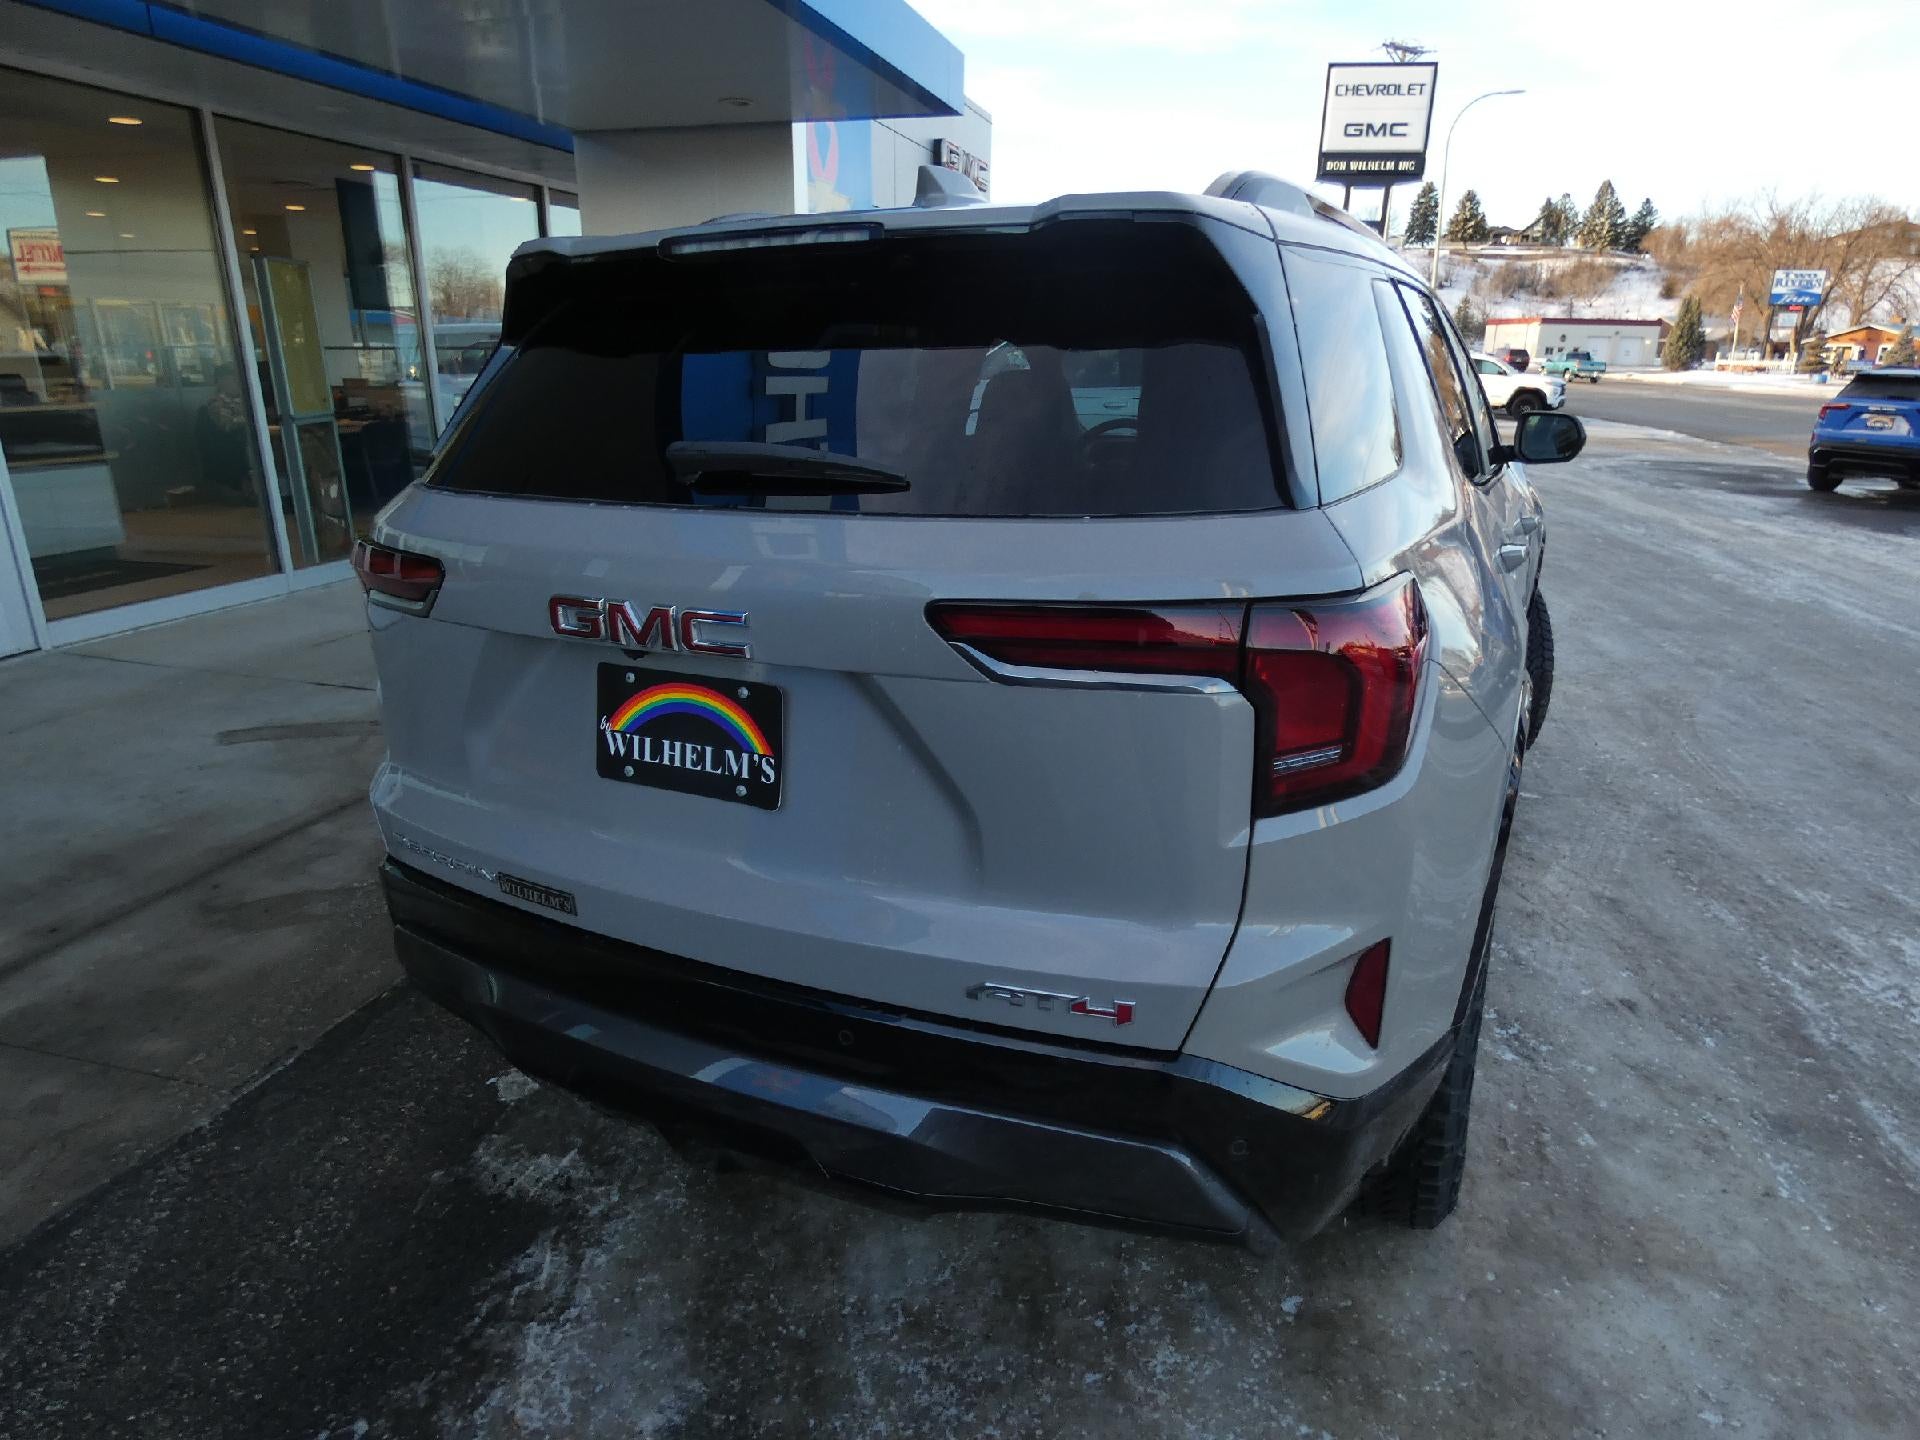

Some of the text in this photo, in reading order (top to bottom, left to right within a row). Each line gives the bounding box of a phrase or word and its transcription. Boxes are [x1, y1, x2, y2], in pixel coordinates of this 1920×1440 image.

[1334, 83, 1427, 96] CHEVROLET
[1343, 122, 1409, 137] GMC
[1325, 160, 1416, 171] DON WILHELM INC
[548, 593, 751, 660] GMC
[605, 731, 776, 784] WILHELM'S
